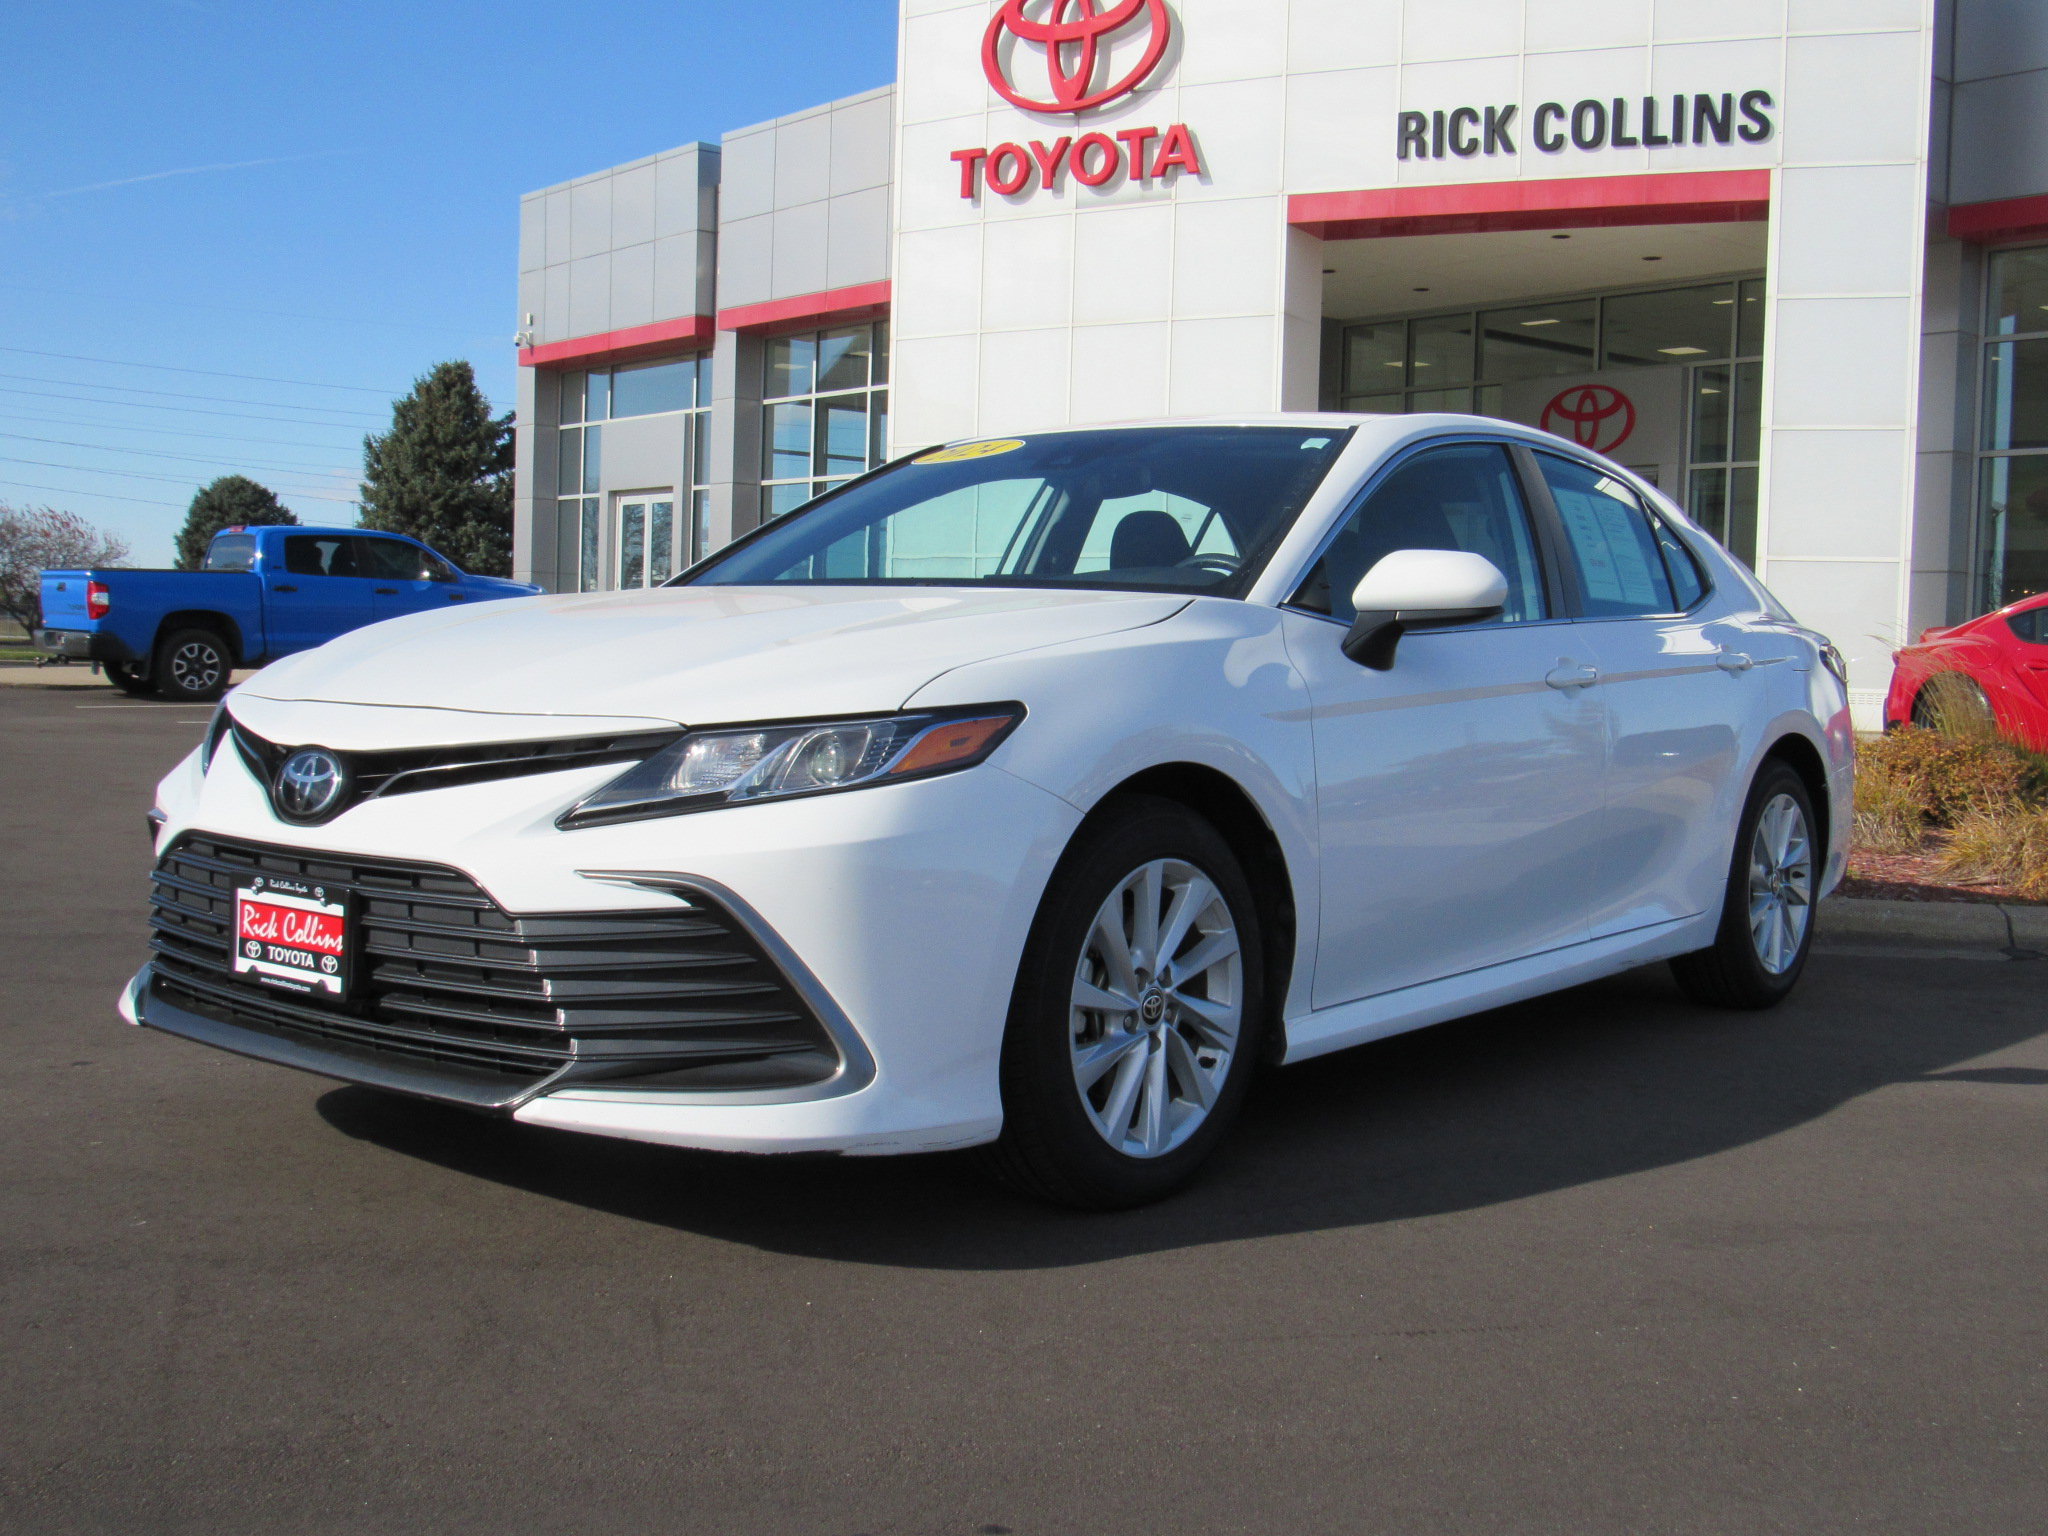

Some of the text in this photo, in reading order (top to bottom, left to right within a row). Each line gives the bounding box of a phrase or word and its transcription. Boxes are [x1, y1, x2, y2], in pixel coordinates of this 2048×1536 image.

[1397, 90, 1772, 159] RICK COLLINS
[951, 123, 1201, 198] TOYOTA
[243, 904, 343, 952] Rick Collins
[267, 945, 314, 968] TOYOTA
